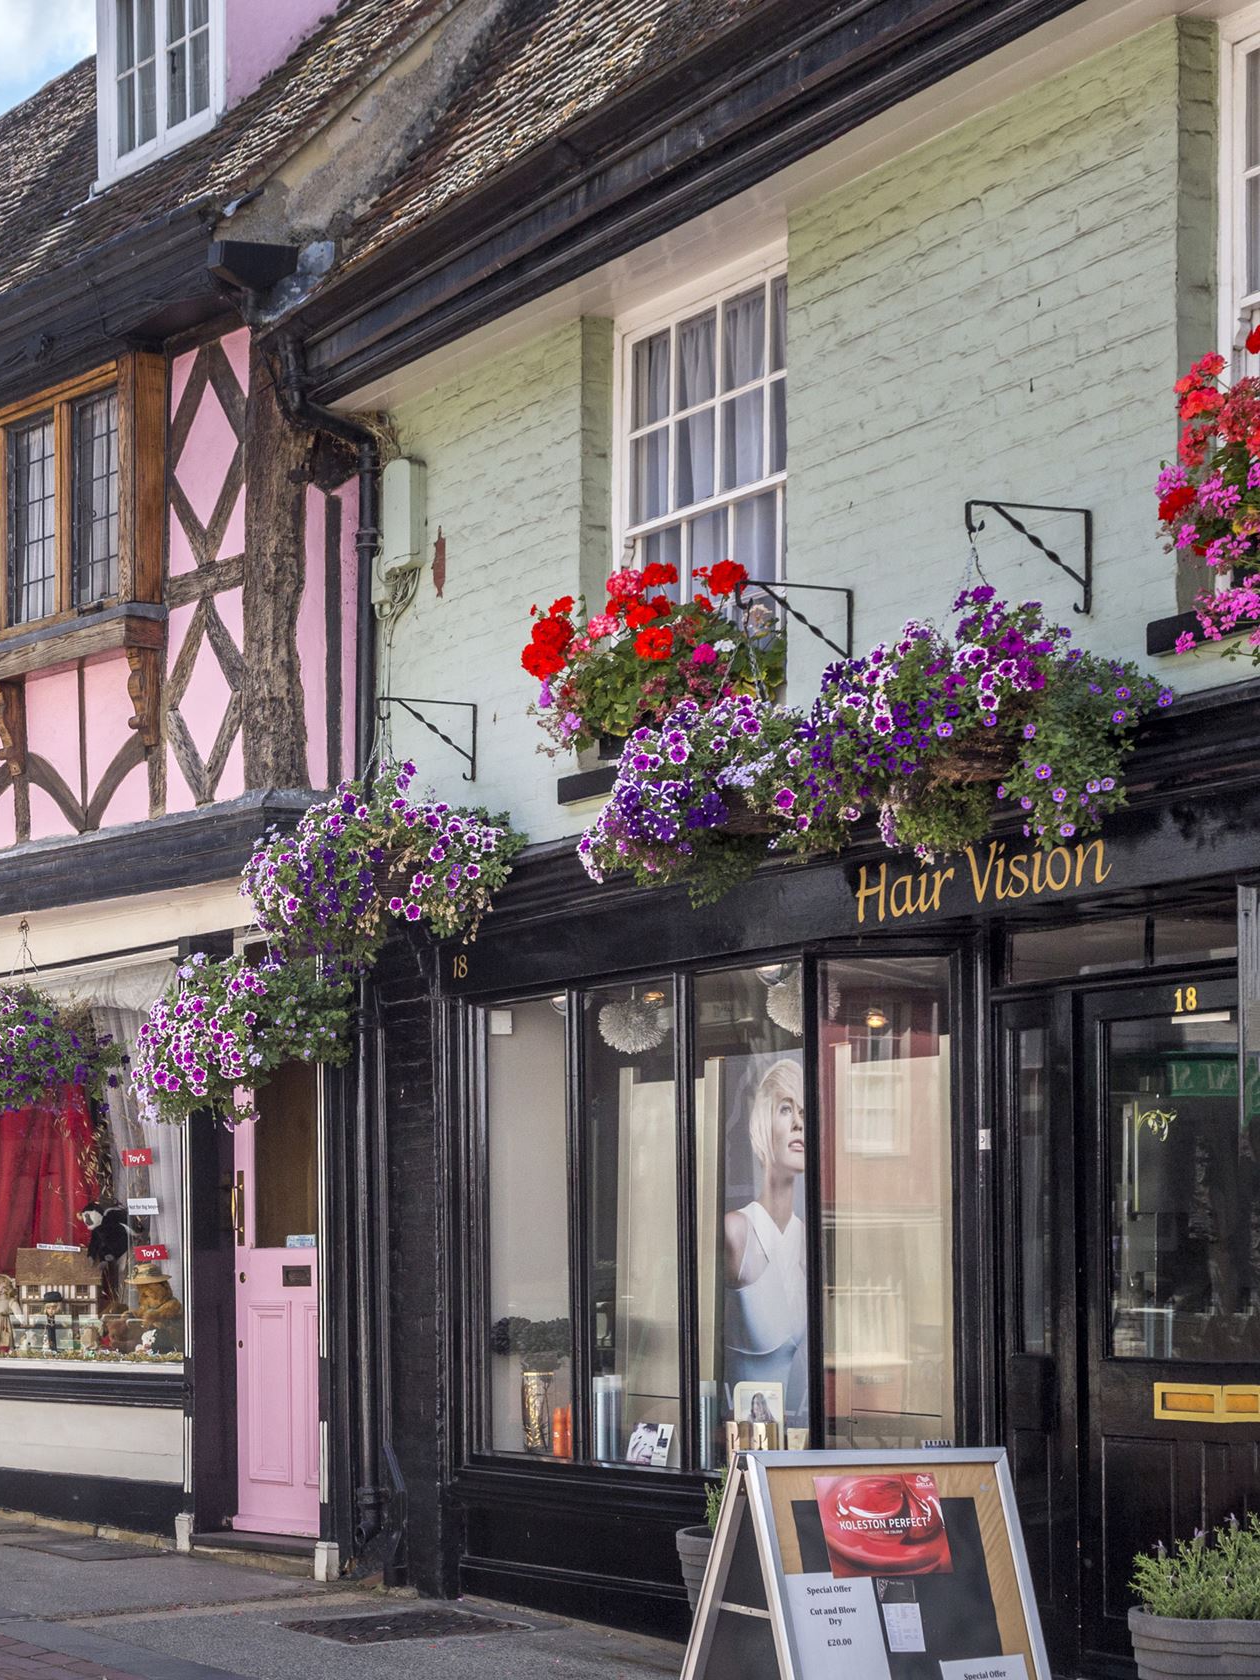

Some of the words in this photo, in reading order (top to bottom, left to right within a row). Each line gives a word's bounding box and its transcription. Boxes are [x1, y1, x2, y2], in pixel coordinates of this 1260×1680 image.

[855, 861, 955, 923] Hair
[965, 838, 1113, 904] Vision
[453, 954, 468, 979] 18
[1174, 986, 1197, 1012] 18
[128, 1153, 146, 1163] Toy's
[141, 1248, 161, 1258] Toy's
[840, 1518, 887, 1531] KOLESTON
[889, 1517, 927, 1528] PERFECT
[806, 1586, 833, 1596] Special
[834, 1585, 852, 1593] Offer
[838, 1606, 857, 1614] Blow
[829, 1618, 842, 1626] Dry
[827, 1638, 852, 1647] £20.00
[964, 1671, 988, 1680] Special
